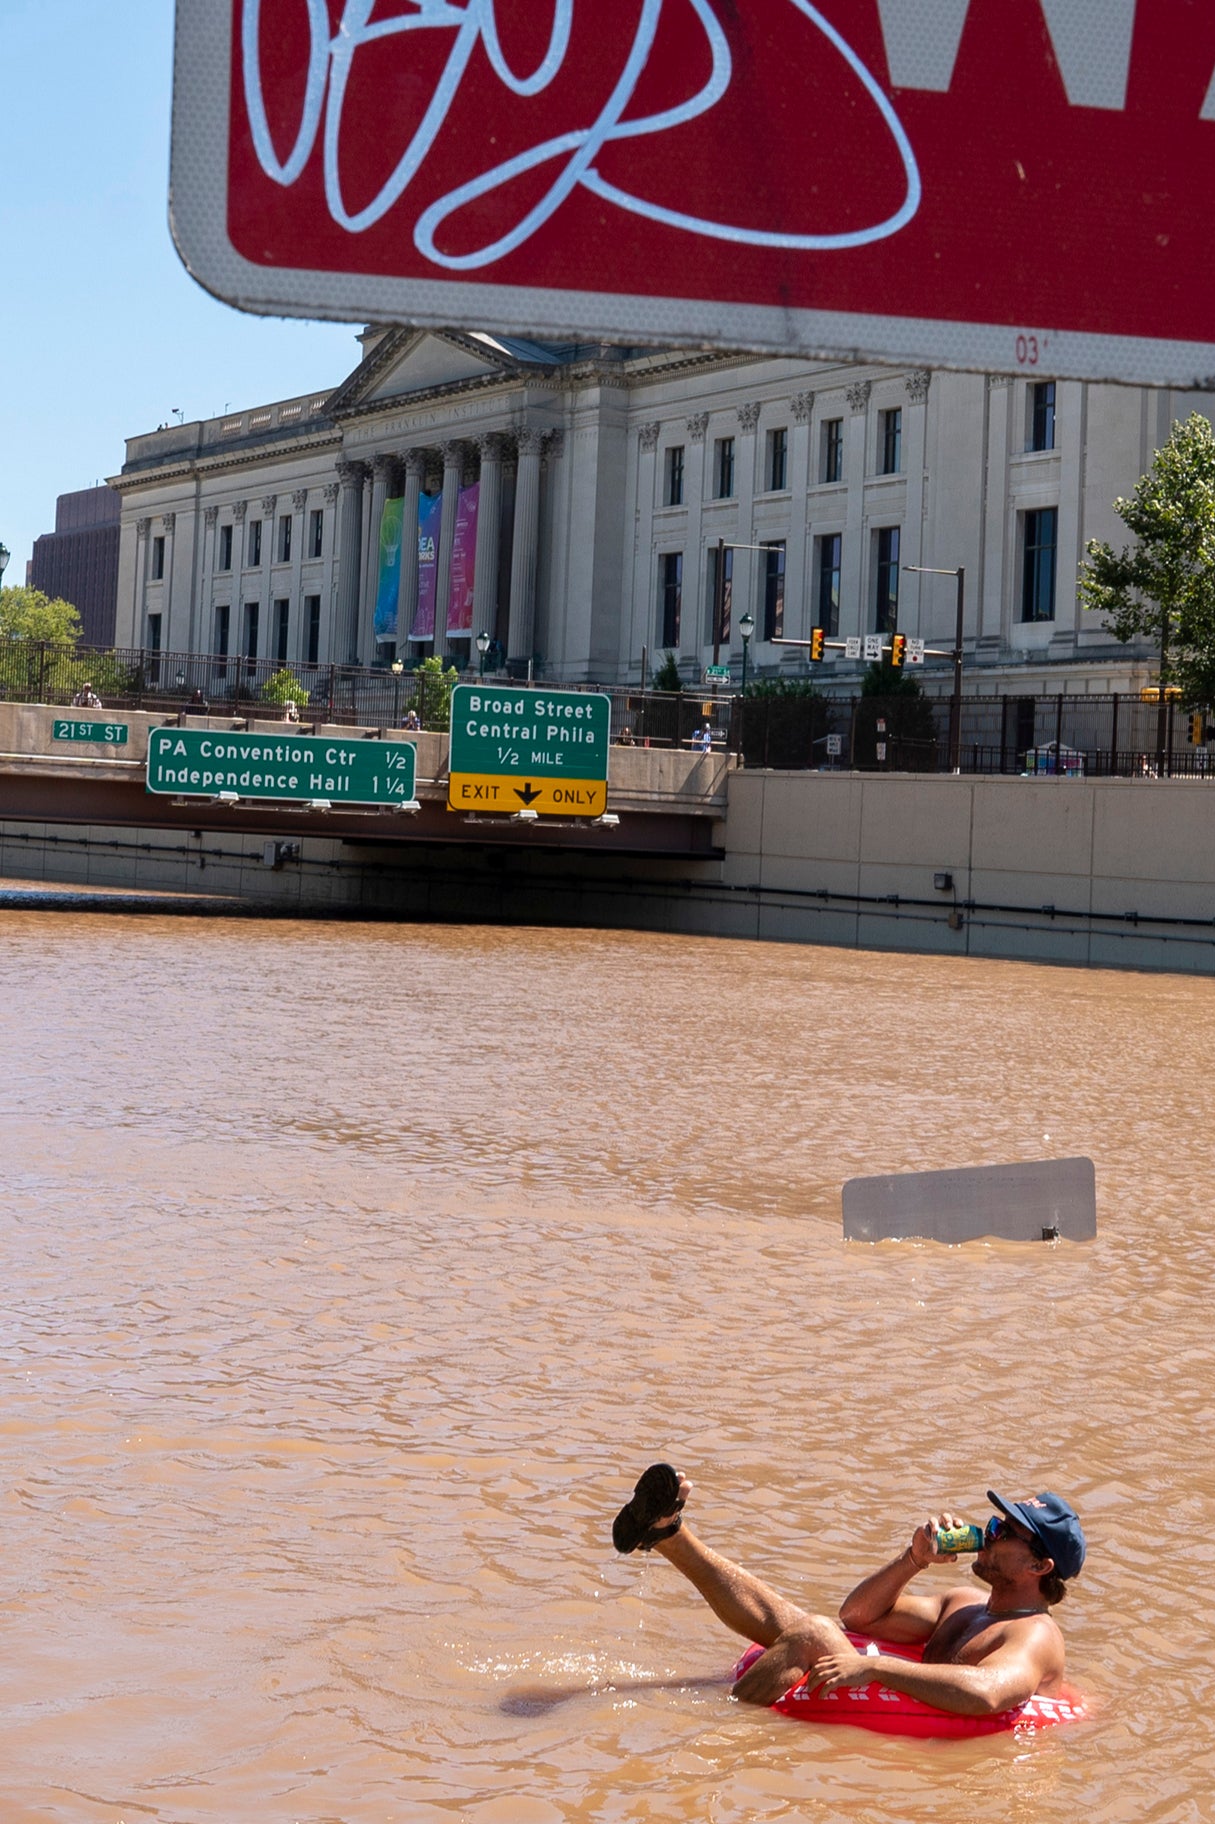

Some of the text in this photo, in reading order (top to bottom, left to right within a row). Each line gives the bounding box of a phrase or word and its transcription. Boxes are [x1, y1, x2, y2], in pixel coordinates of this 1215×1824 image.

[418, 536, 435, 552] EA
[418, 551, 435, 561] RKS
[469, 696, 594, 719] Broad Street
[104, 725, 123, 741] ST
[466, 720, 595, 743] Central Phila
[159, 738, 188, 756] PA
[200, 740, 314, 763] Convention
[325, 747, 357, 766] Ctr
[531, 751, 564, 765] MILE
[158, 765, 299, 789] Independence
[310, 773, 349, 792] Hall
[461, 784, 597, 805] EXIT ONLY
